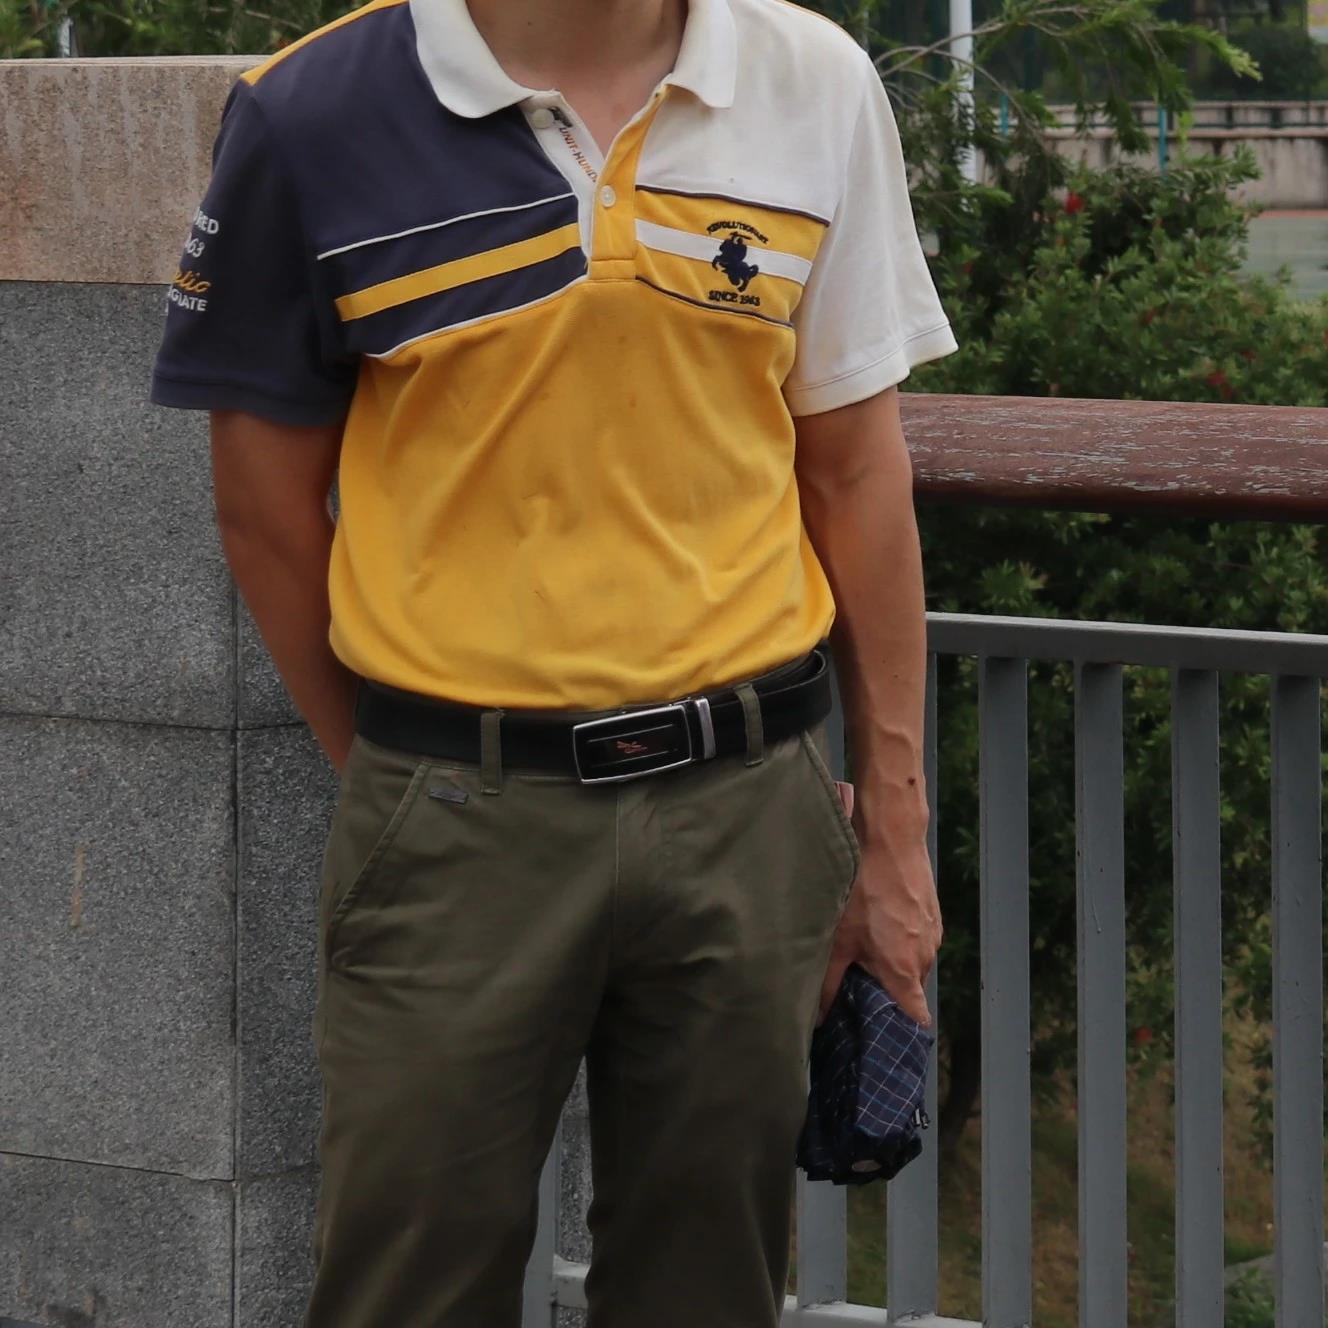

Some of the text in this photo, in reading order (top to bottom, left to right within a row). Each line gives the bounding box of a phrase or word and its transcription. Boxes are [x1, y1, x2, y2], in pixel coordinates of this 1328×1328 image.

[185, 232, 205, 258] 63
[167, 284, 208, 312] GIATE
[708, 290, 738, 303] SINCE
